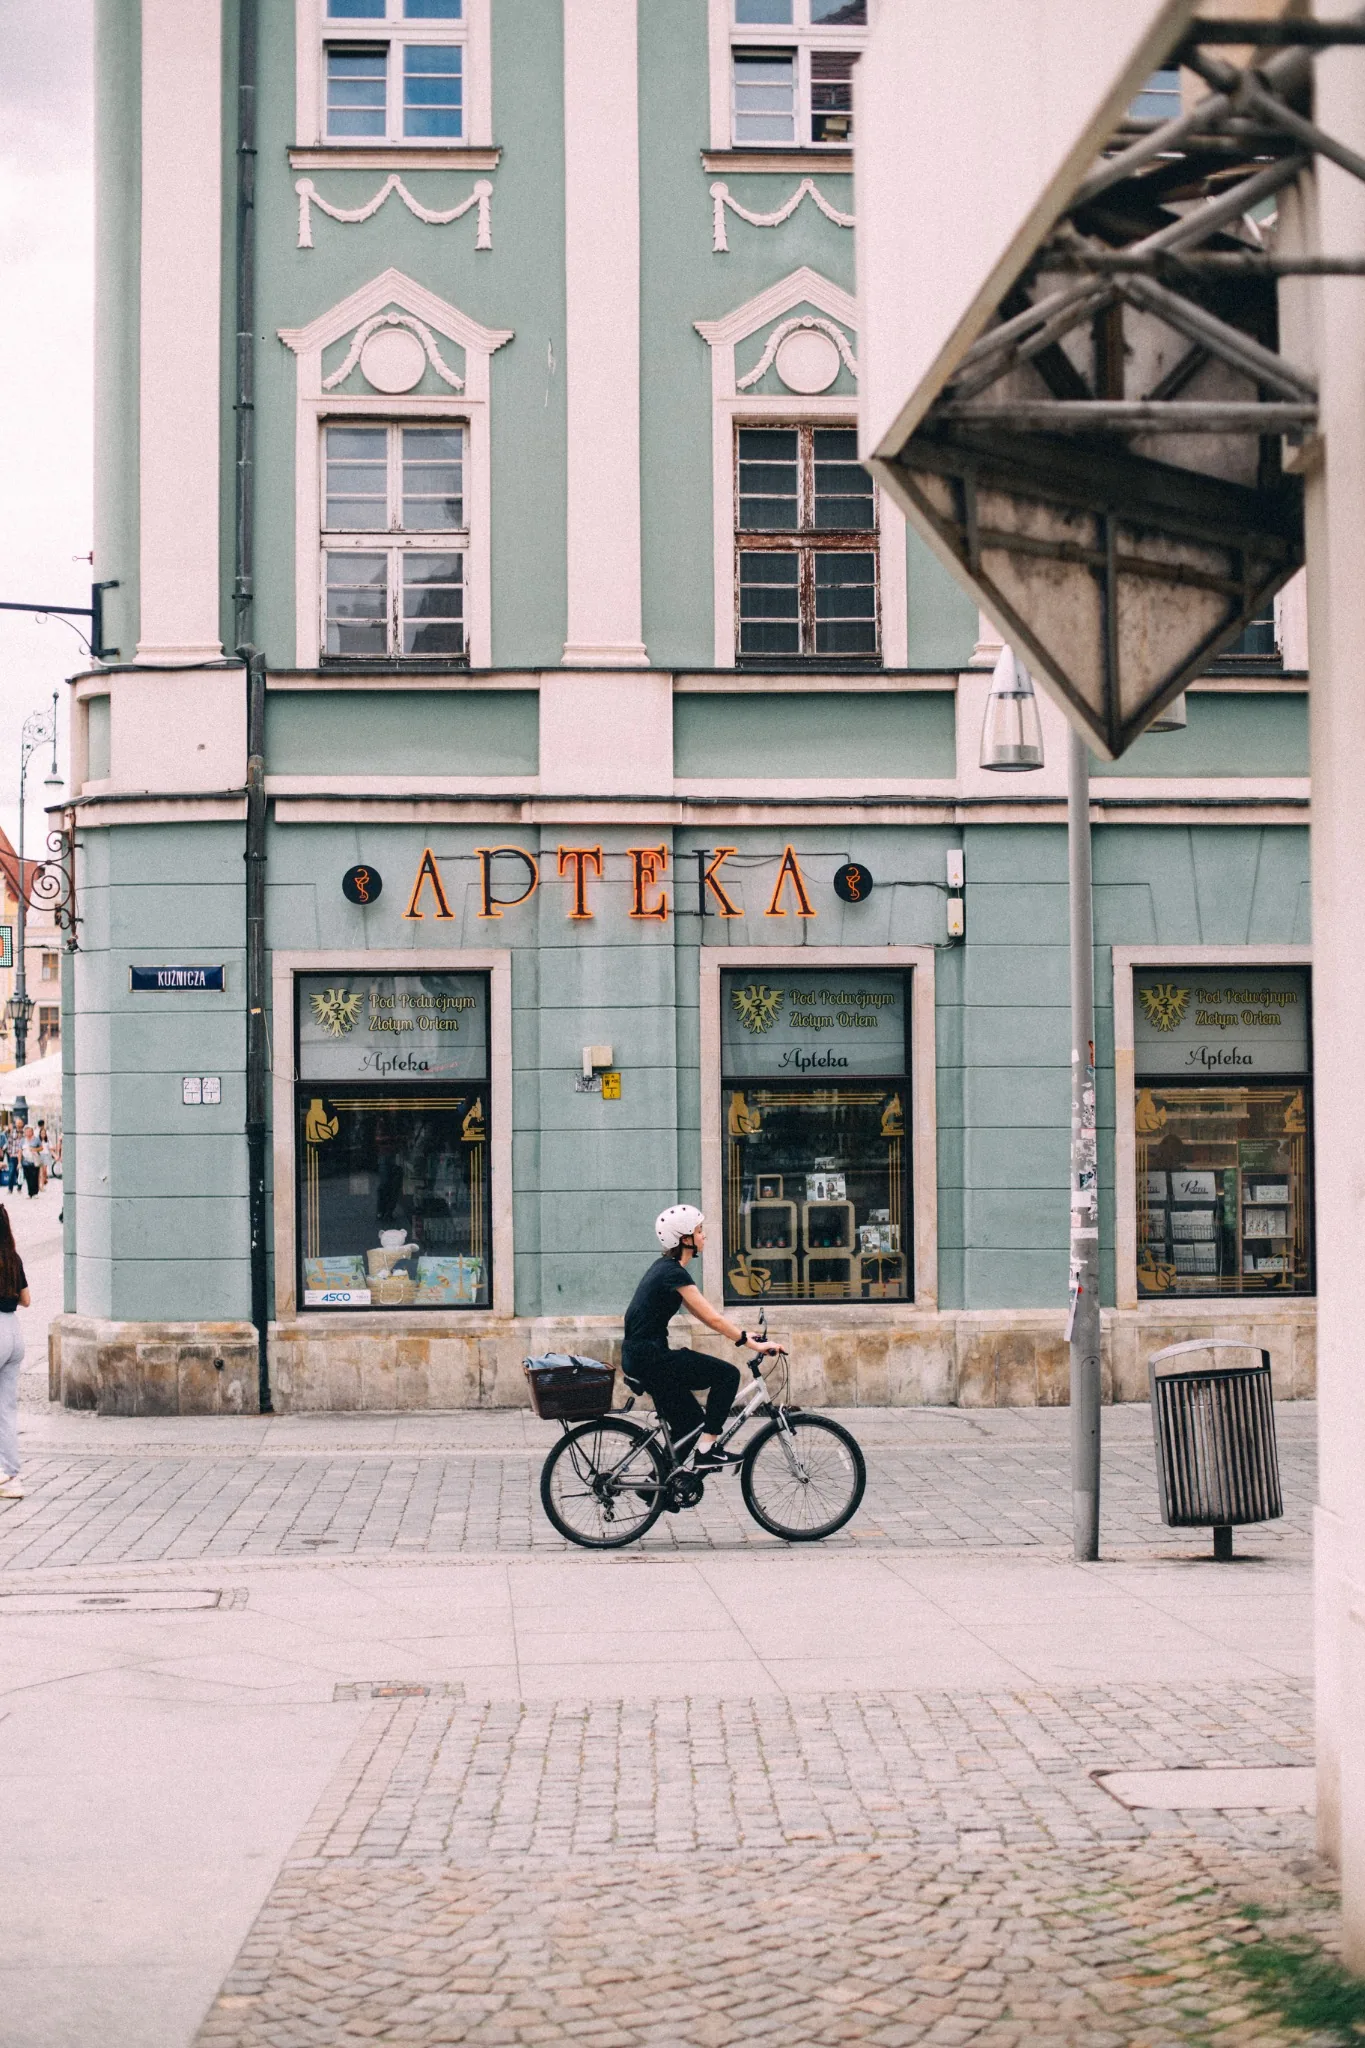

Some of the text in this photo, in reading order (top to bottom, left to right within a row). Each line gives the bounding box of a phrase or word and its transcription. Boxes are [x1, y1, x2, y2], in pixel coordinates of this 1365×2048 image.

[403, 843, 816, 922] APTEKA
[368, 993, 476, 1013] Pod Podwójnym
[789, 989, 895, 1009] Pod Podwójnym
[1195, 988, 1221, 1004] Pod
[368, 1015, 414, 1035] Złotym
[789, 1011, 834, 1031] Złotym
[358, 1051, 429, 1076] Apteka
[778, 1048, 849, 1072] Apteka
[1185, 1046, 1253, 1070] Apteka
[321, 1292, 351, 1302] ASCO
